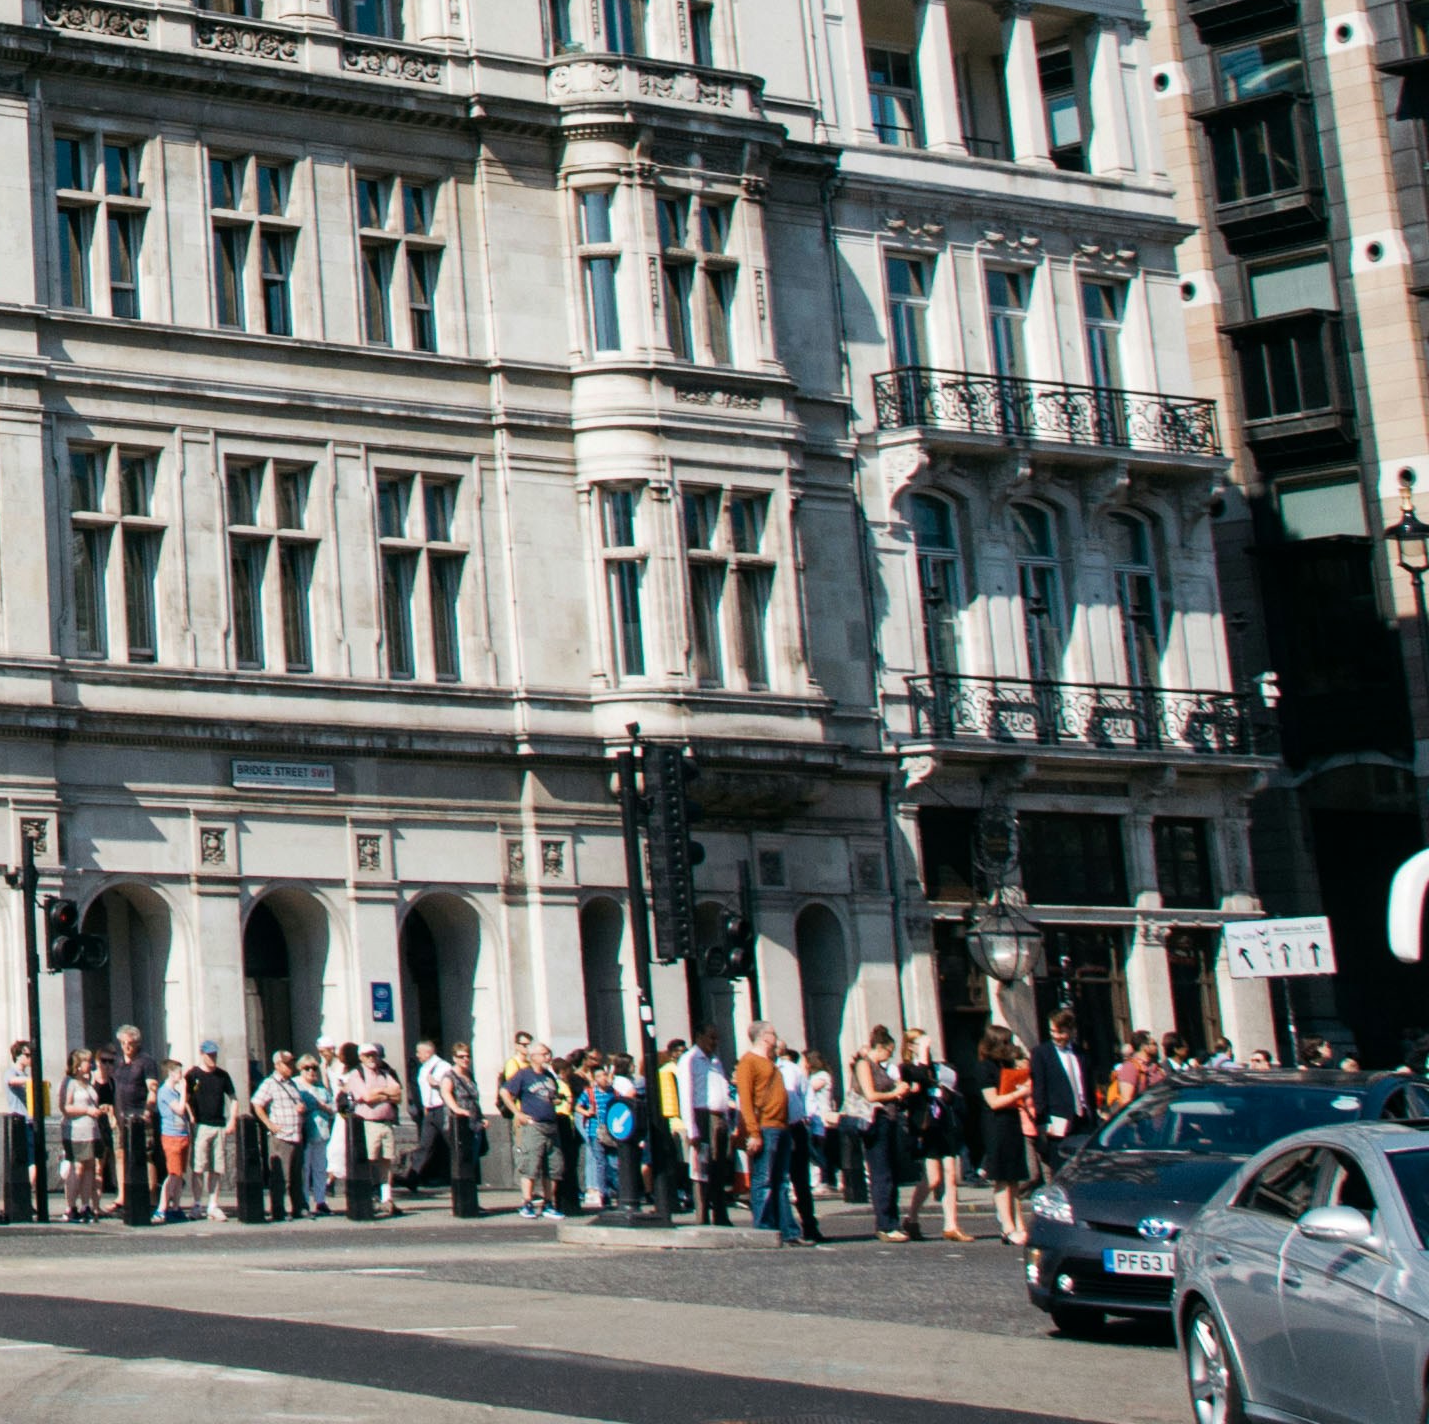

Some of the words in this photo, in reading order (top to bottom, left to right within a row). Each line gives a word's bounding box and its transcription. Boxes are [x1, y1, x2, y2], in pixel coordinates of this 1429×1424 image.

[236, 764, 272, 776] BRIDGE
[274, 766, 308, 777] STREET
[311, 767, 330, 778] SW1
[1116, 1253, 1163, 1272] PF63
